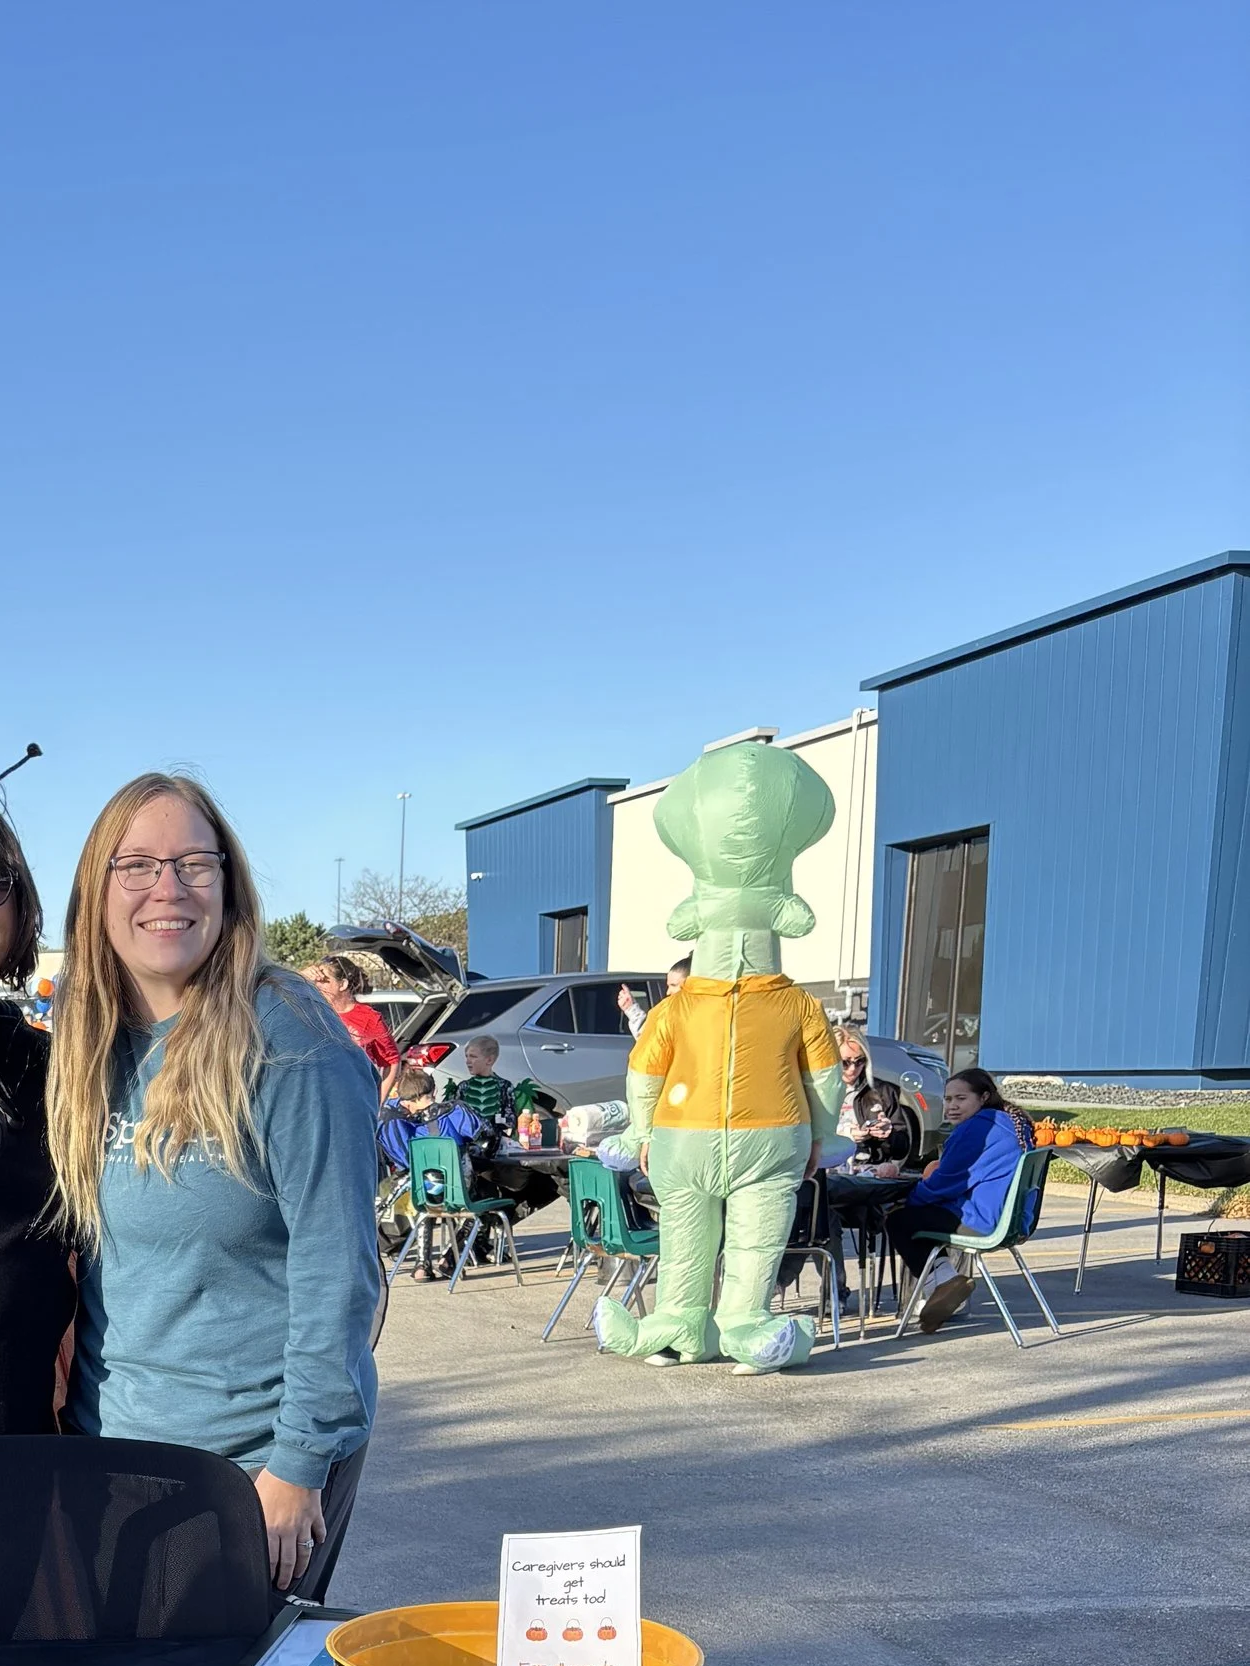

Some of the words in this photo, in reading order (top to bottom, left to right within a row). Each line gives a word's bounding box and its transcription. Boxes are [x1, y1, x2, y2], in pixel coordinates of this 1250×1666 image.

[511, 1560, 585, 1577] Caregivers
[589, 1554, 626, 1569] should
[563, 1576, 584, 1594] get
[535, 1594, 578, 1605] treats
[583, 1588, 606, 1604] too!
